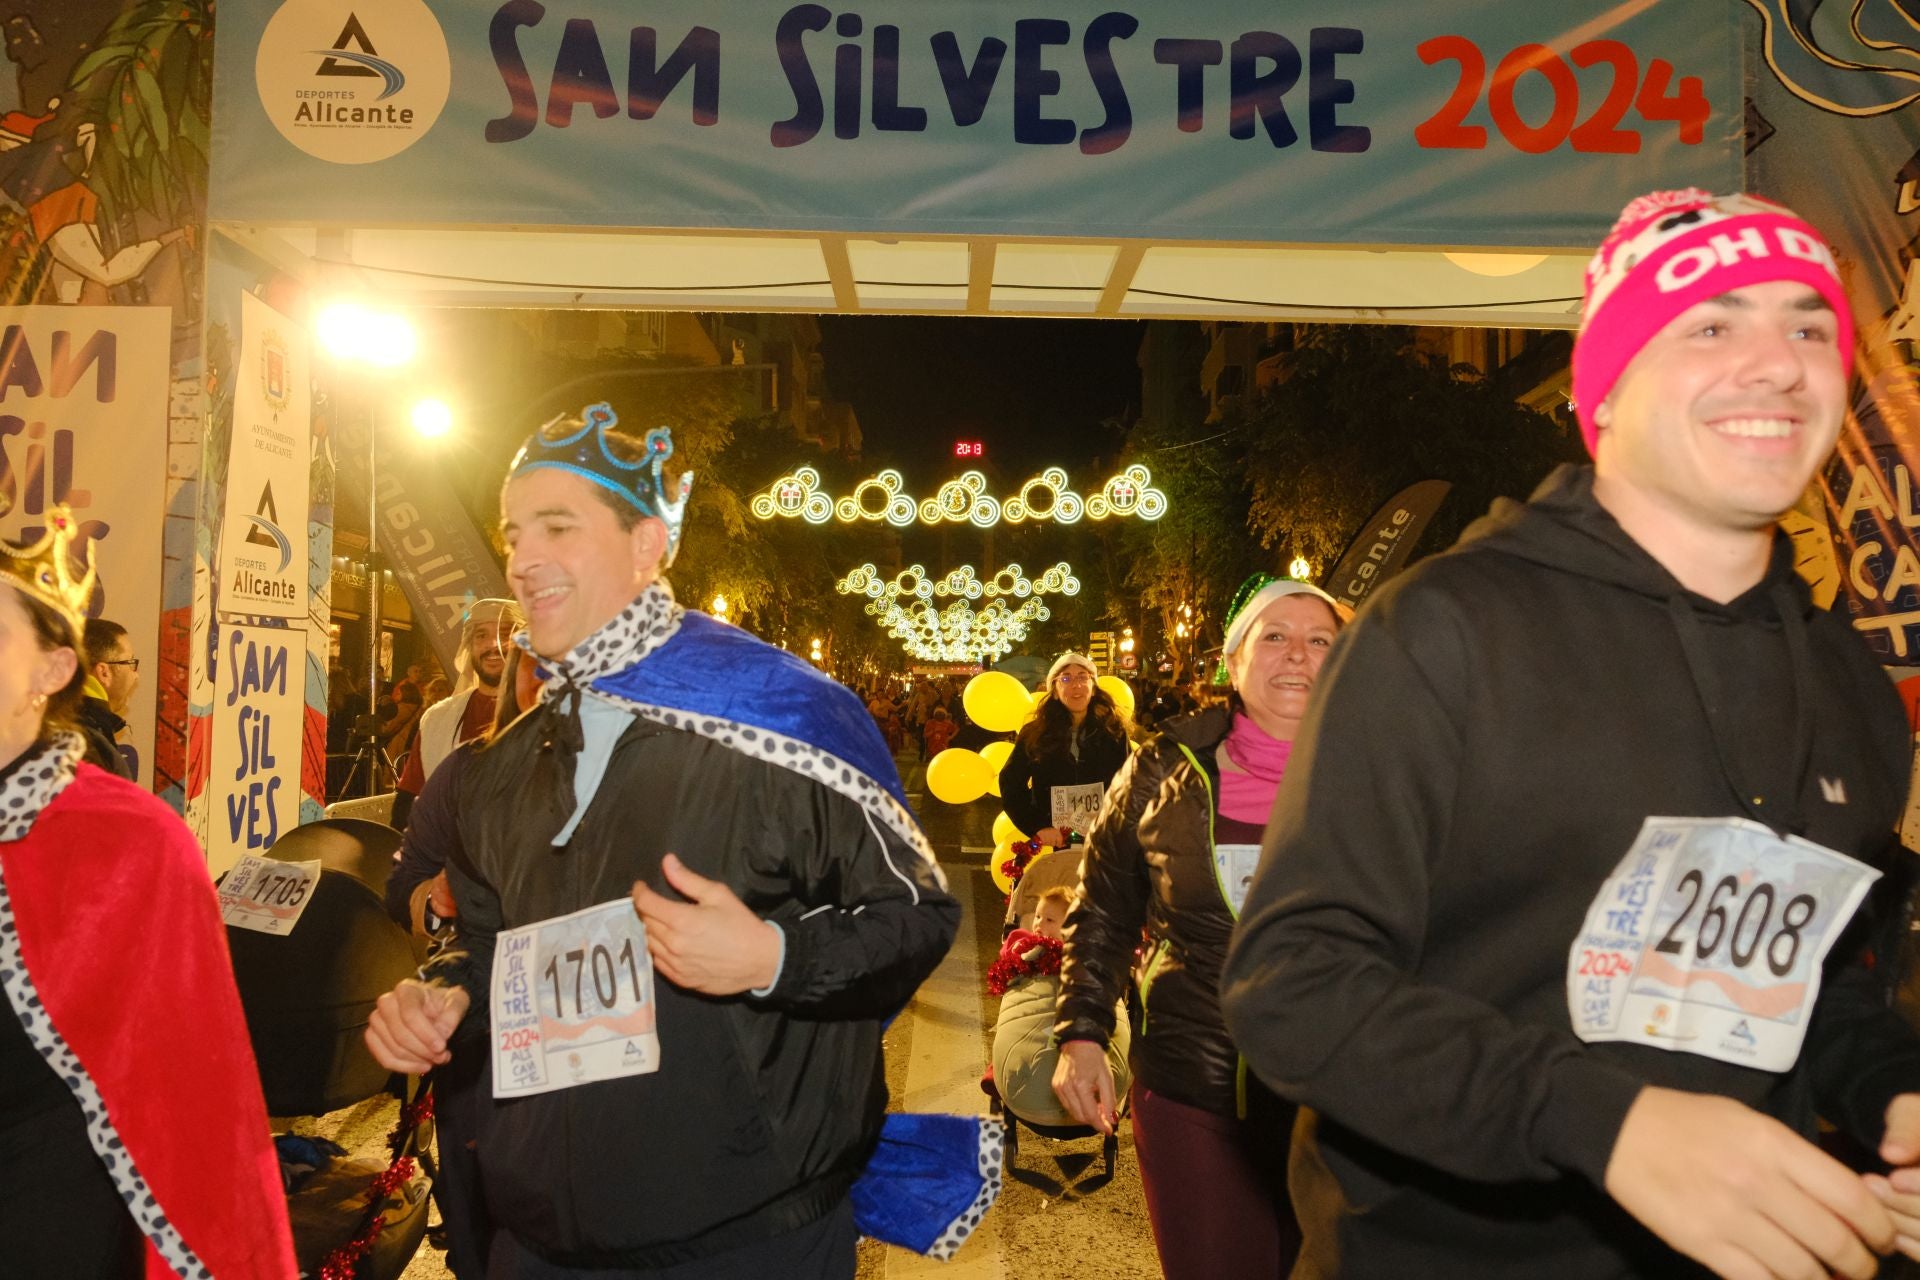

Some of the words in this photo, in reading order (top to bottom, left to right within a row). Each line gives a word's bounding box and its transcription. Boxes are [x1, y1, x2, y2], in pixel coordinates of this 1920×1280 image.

[485, 0, 720, 144] SAN
[1414, 35, 1710, 154] 2024
[296, 90, 355, 99] DEPORTES
[295, 101, 414, 123] Alicante
[1655, 227, 1770, 293] OH
[956, 443, 982, 455] 20:13
[234, 557, 267, 571] DEPORTES
[233, 570, 296, 599] Alicante
[227, 630, 288, 706] SAN
[227, 776, 281, 849] VES
[252, 874, 311, 906] 1705
[1606, 910, 1643, 936] TRE
[1655, 869, 1816, 977] 2608
[504, 935, 531, 957] SAN
[1577, 950, 1632, 977] 2024
[504, 973, 528, 994] VES
[545, 938, 641, 1018] 1701
[503, 994, 531, 1015] TRE
[501, 1029, 540, 1051] 2024
